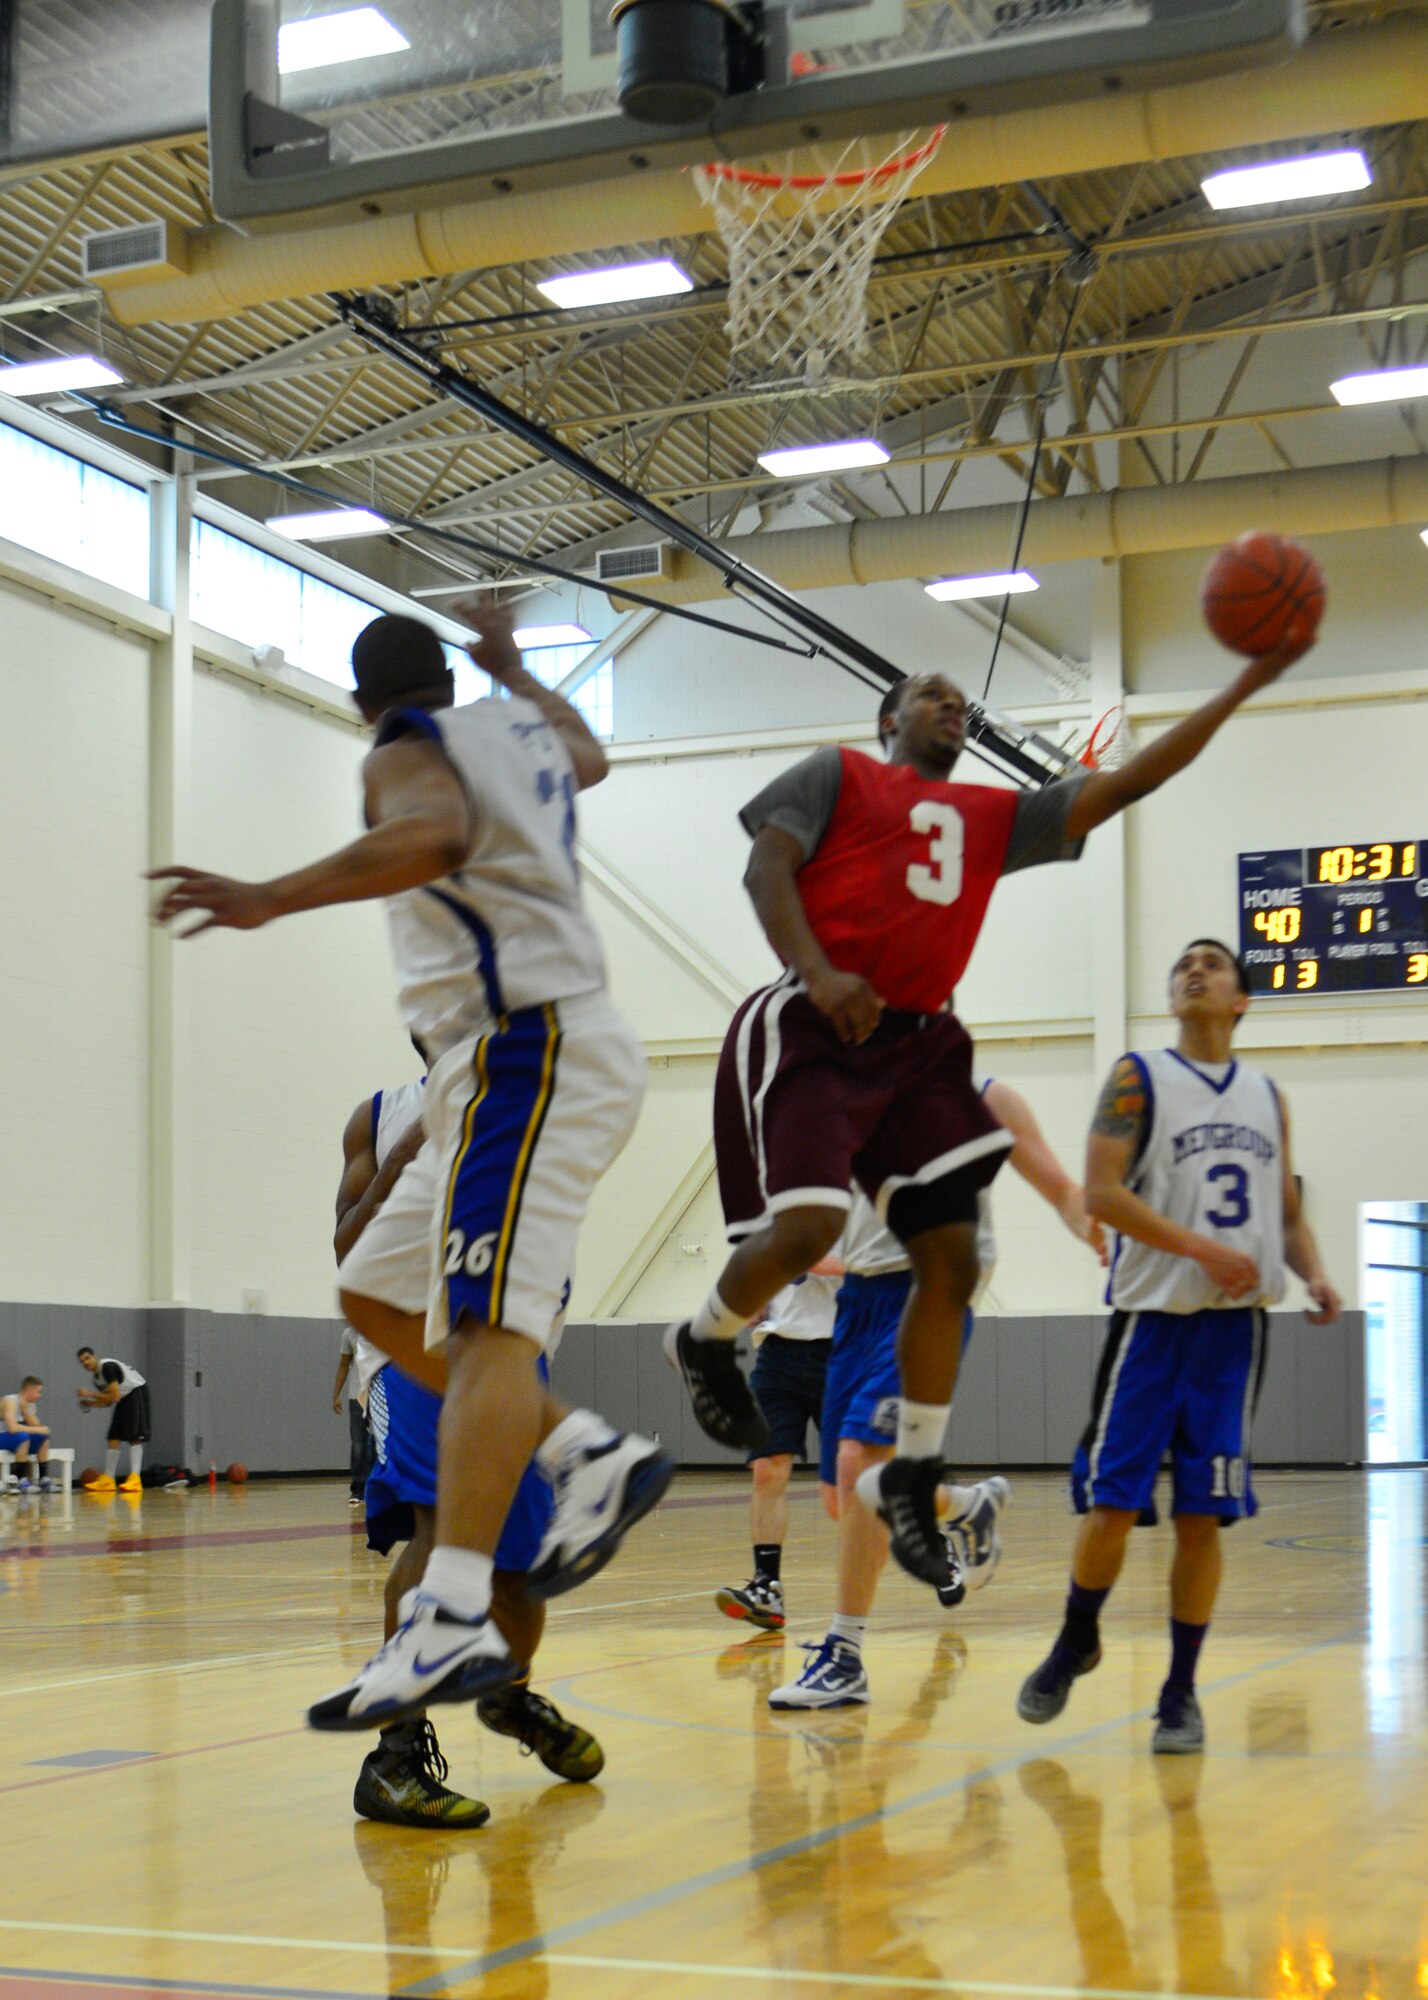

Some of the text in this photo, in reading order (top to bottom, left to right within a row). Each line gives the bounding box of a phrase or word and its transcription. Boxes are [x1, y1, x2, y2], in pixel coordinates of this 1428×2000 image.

[905, 800, 964, 906] 3
[1319, 844, 1416, 883] 10:31
[1243, 887, 1302, 909] HOME
[1337, 891, 1385, 906] PERIOD
[1254, 907, 1302, 943] 40
[1359, 907, 1373, 933] 1
[1244, 948, 1286, 964] FOULS
[1273, 964, 1286, 989] 1
[1296, 960, 1318, 989] 3
[1206, 1163, 1250, 1229] 3
[443, 1228, 500, 1277] 26
